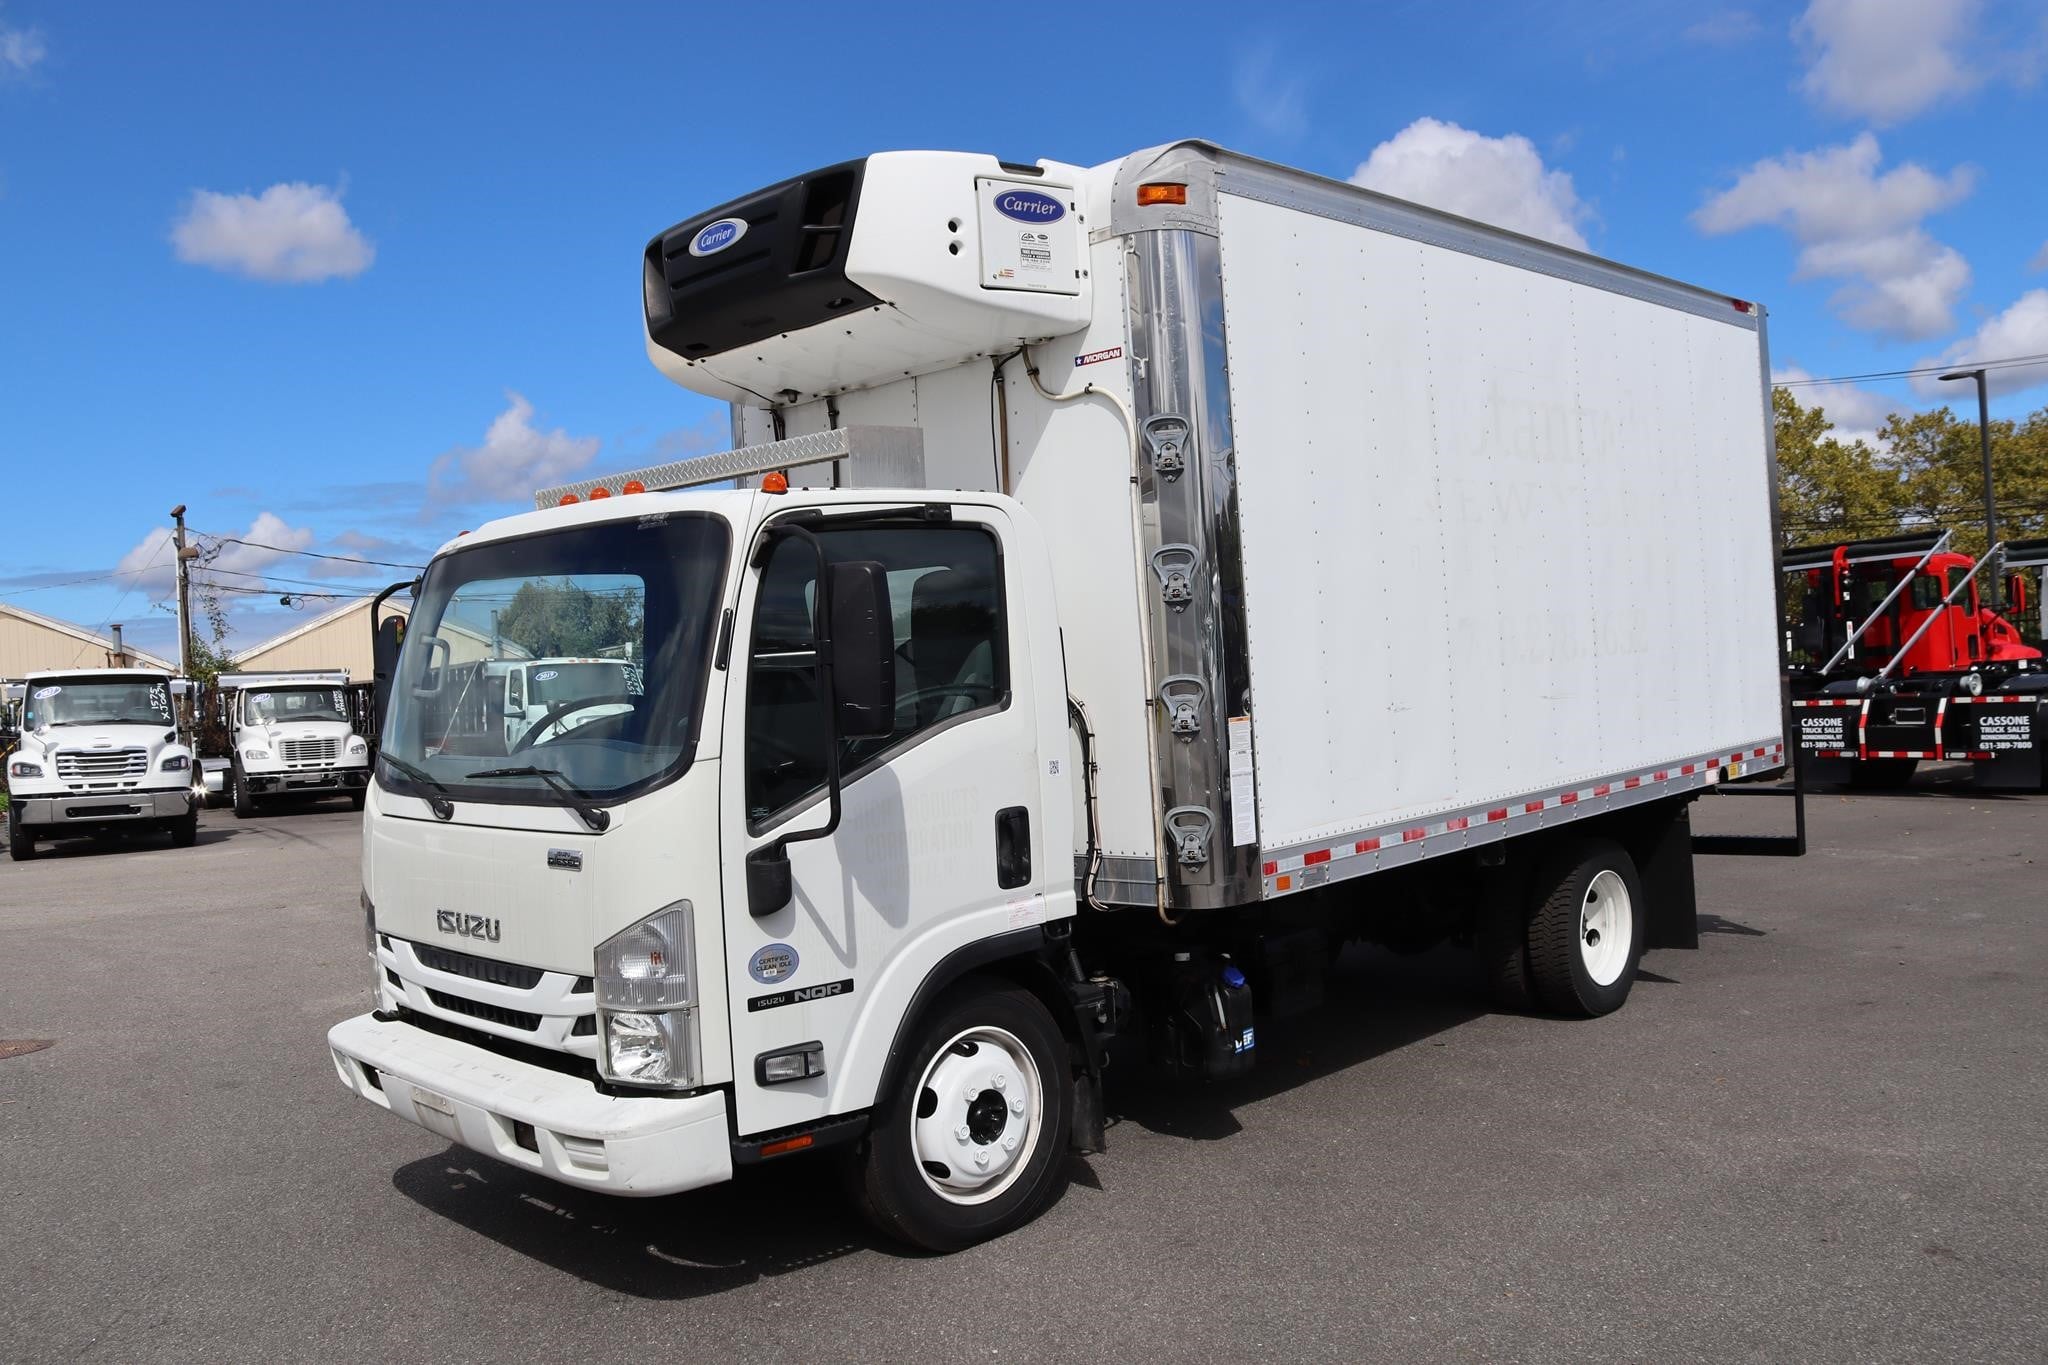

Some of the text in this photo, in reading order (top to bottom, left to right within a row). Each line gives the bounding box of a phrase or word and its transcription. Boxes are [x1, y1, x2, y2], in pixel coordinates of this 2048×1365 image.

[1004, 196, 1056, 215] Carrier
[701, 228, 732, 248] Carrier
[1083, 349, 1121, 364] MORGAN
[150, 686, 160, 710] 1575
[1801, 718, 1843, 727] CASSONE
[1980, 716, 2030, 726] CASSONE
[437, 909, 500, 943] ISUZU
[756, 960, 793, 972] CLEAN IDLE
[759, 954, 789, 965] CERTIFIED
[757, 983, 842, 1008] ISUZU NQR
